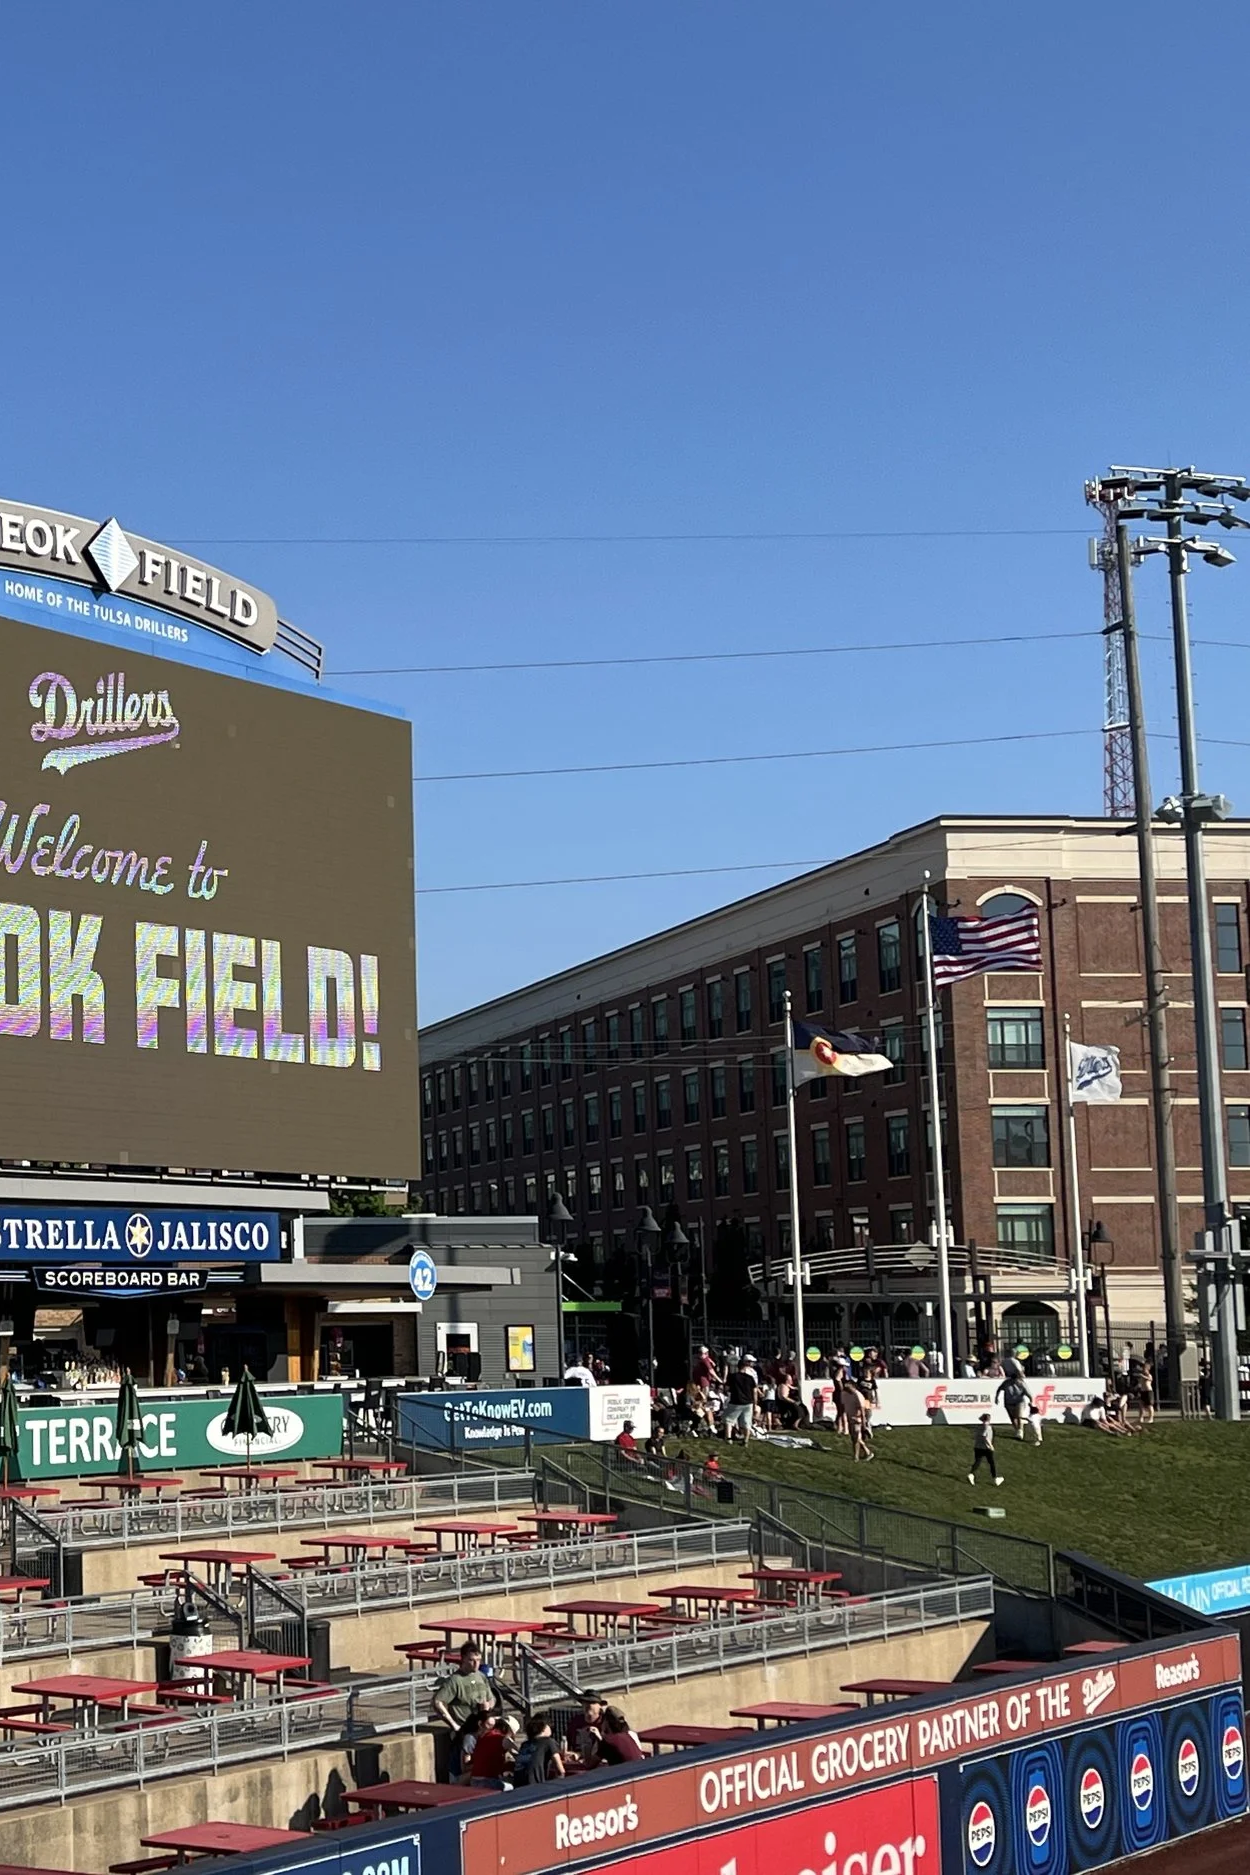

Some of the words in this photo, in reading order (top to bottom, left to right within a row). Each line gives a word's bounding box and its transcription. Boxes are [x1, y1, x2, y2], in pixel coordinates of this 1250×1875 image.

[141, 549, 259, 628] FIELD
[4, 579, 43, 604] HOME
[46, 592, 63, 608] OF
[66, 597, 91, 616] THE
[93, 604, 132, 627] TULSA
[134, 615, 189, 643] DRILLERS
[28, 671, 179, 744] Drillers
[187, 840, 230, 900] to
[134, 921, 383, 1073] FIELD!
[157, 1220, 270, 1251] JALISCO
[44, 1270, 163, 1287] SCOREBOARD
[167, 1271, 200, 1286] BAR
[414, 1267, 434, 1291] 42
[1155, 1652, 1200, 1690] Reasor's
[700, 1750, 805, 1814] OFFICIAL
[811, 1722, 911, 1785] GROCERY
[918, 1701, 1001, 1758] PARTNER
[1005, 1693, 1032, 1731] OF
[1036, 1682, 1071, 1723] THE
[1082, 1789, 1102, 1806] PEPSI
[1133, 1774, 1151, 1789] PEPSI
[554, 1793, 639, 1851] Reasor's
[1028, 1806, 1049, 1824] PEPSI
[971, 1826, 993, 1845] PEPSI
